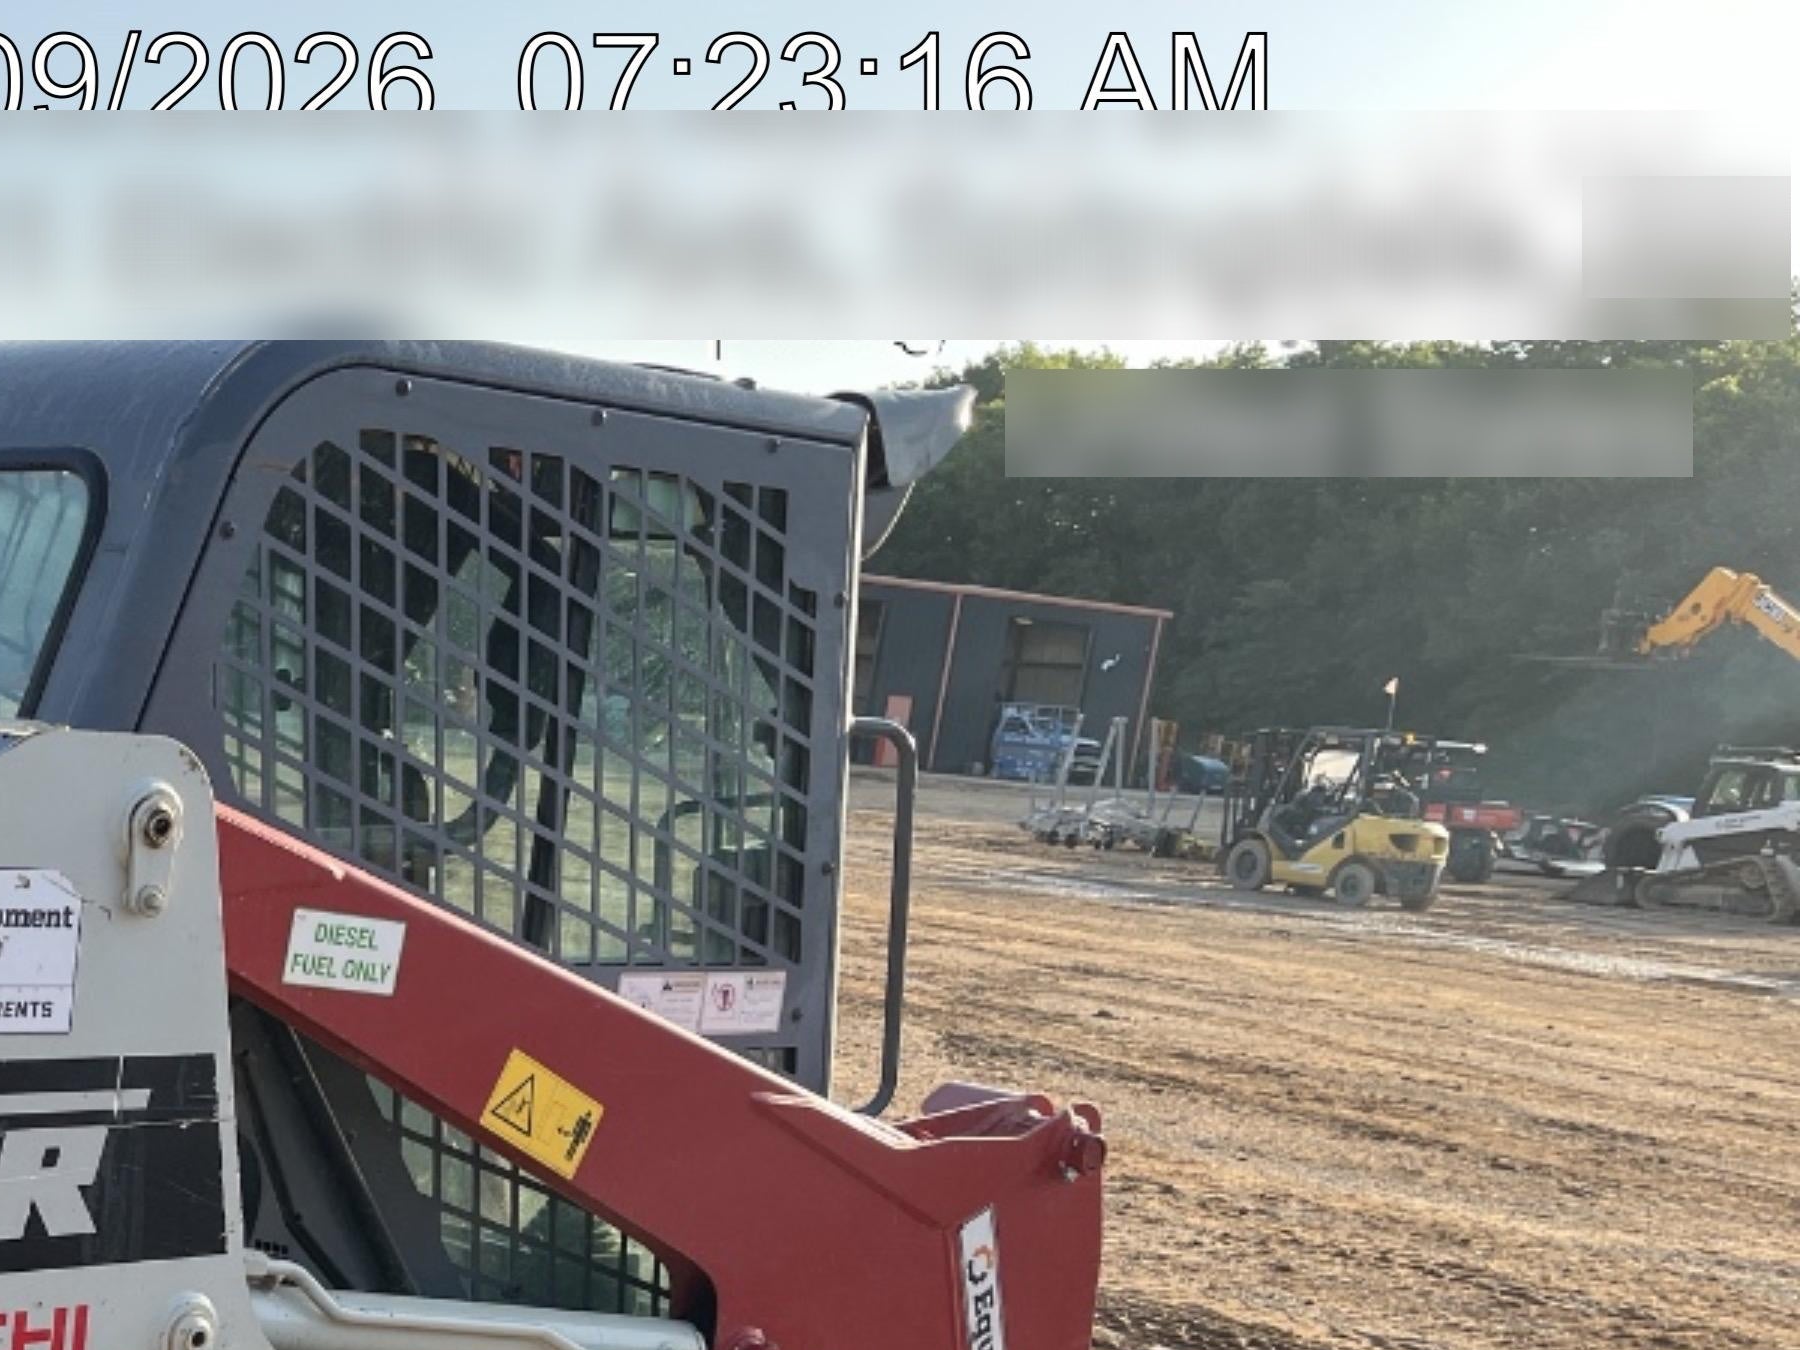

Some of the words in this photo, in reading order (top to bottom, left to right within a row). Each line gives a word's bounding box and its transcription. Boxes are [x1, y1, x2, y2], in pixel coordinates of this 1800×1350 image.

[313, 922, 379, 951] DIESEL
[289, 952, 337, 979] FUEL
[341, 959, 392, 984] ONLY
